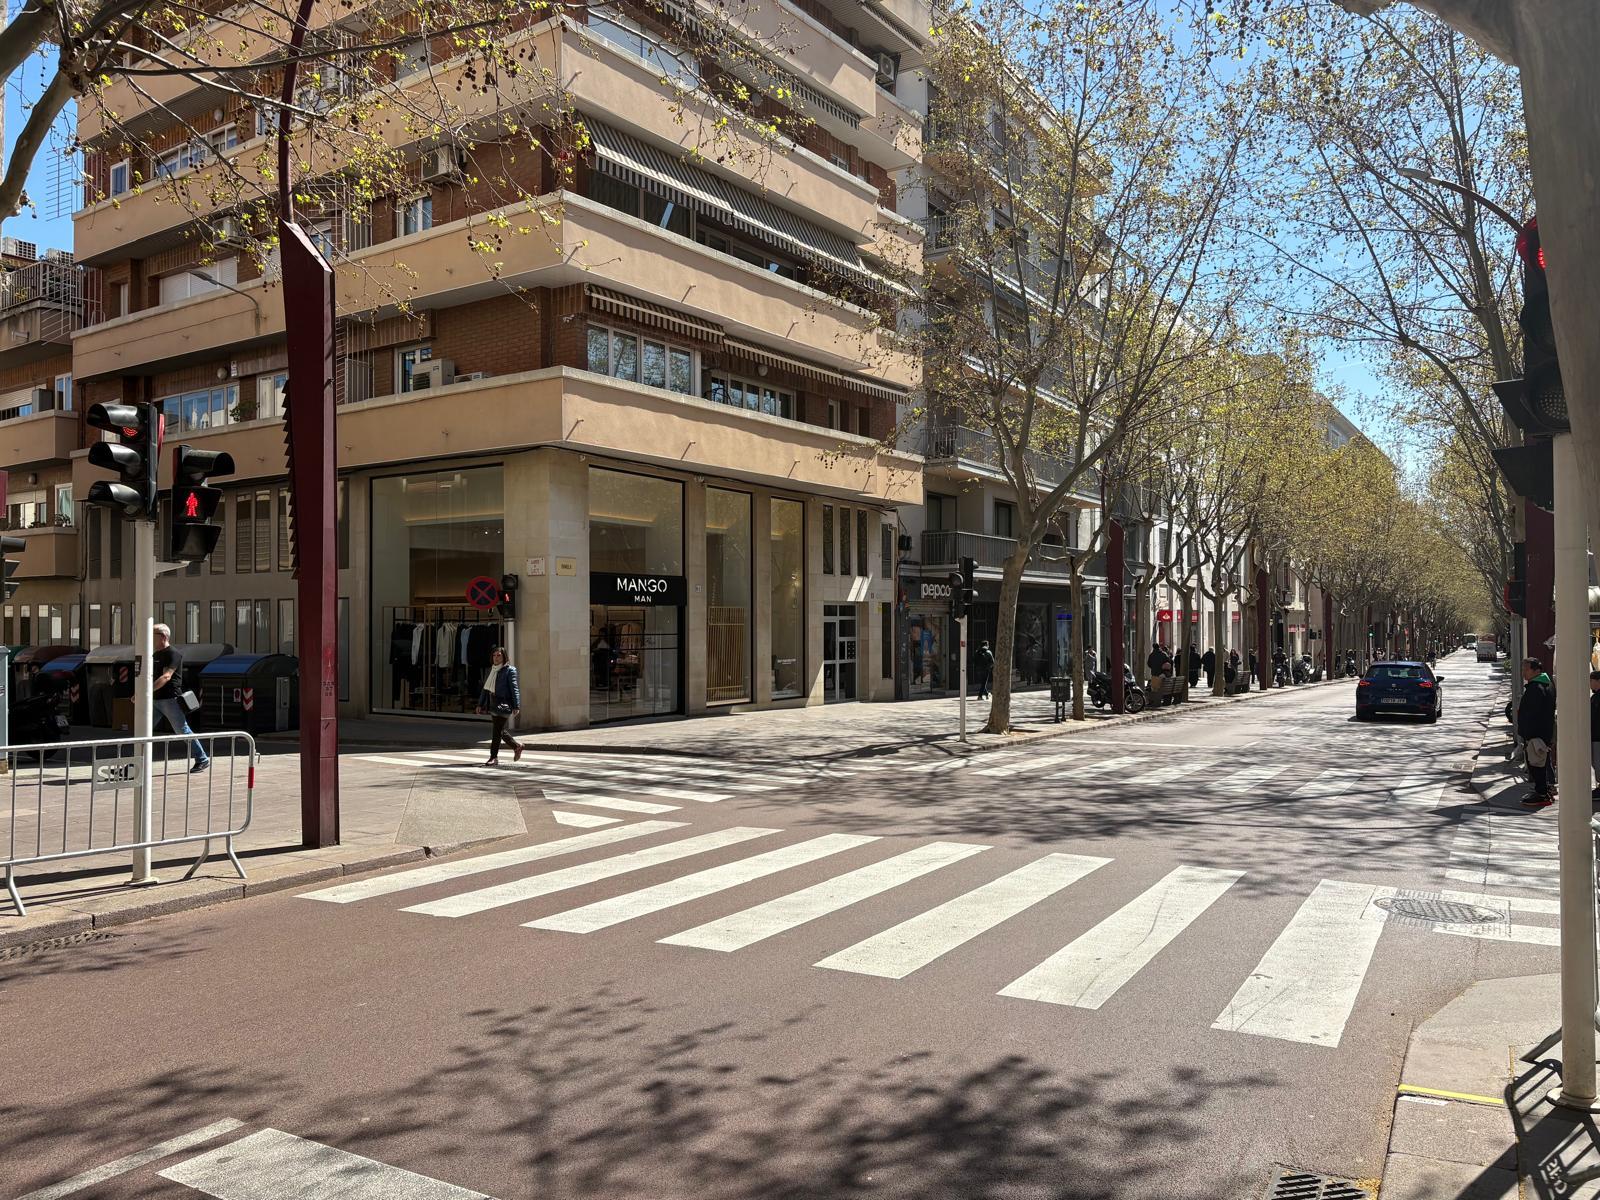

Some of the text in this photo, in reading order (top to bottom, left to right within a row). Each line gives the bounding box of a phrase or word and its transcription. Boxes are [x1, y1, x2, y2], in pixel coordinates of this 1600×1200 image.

[616, 577, 668, 593] MANGO
[920, 583, 952, 599] pepco
[634, 595, 652, 603] MAN
